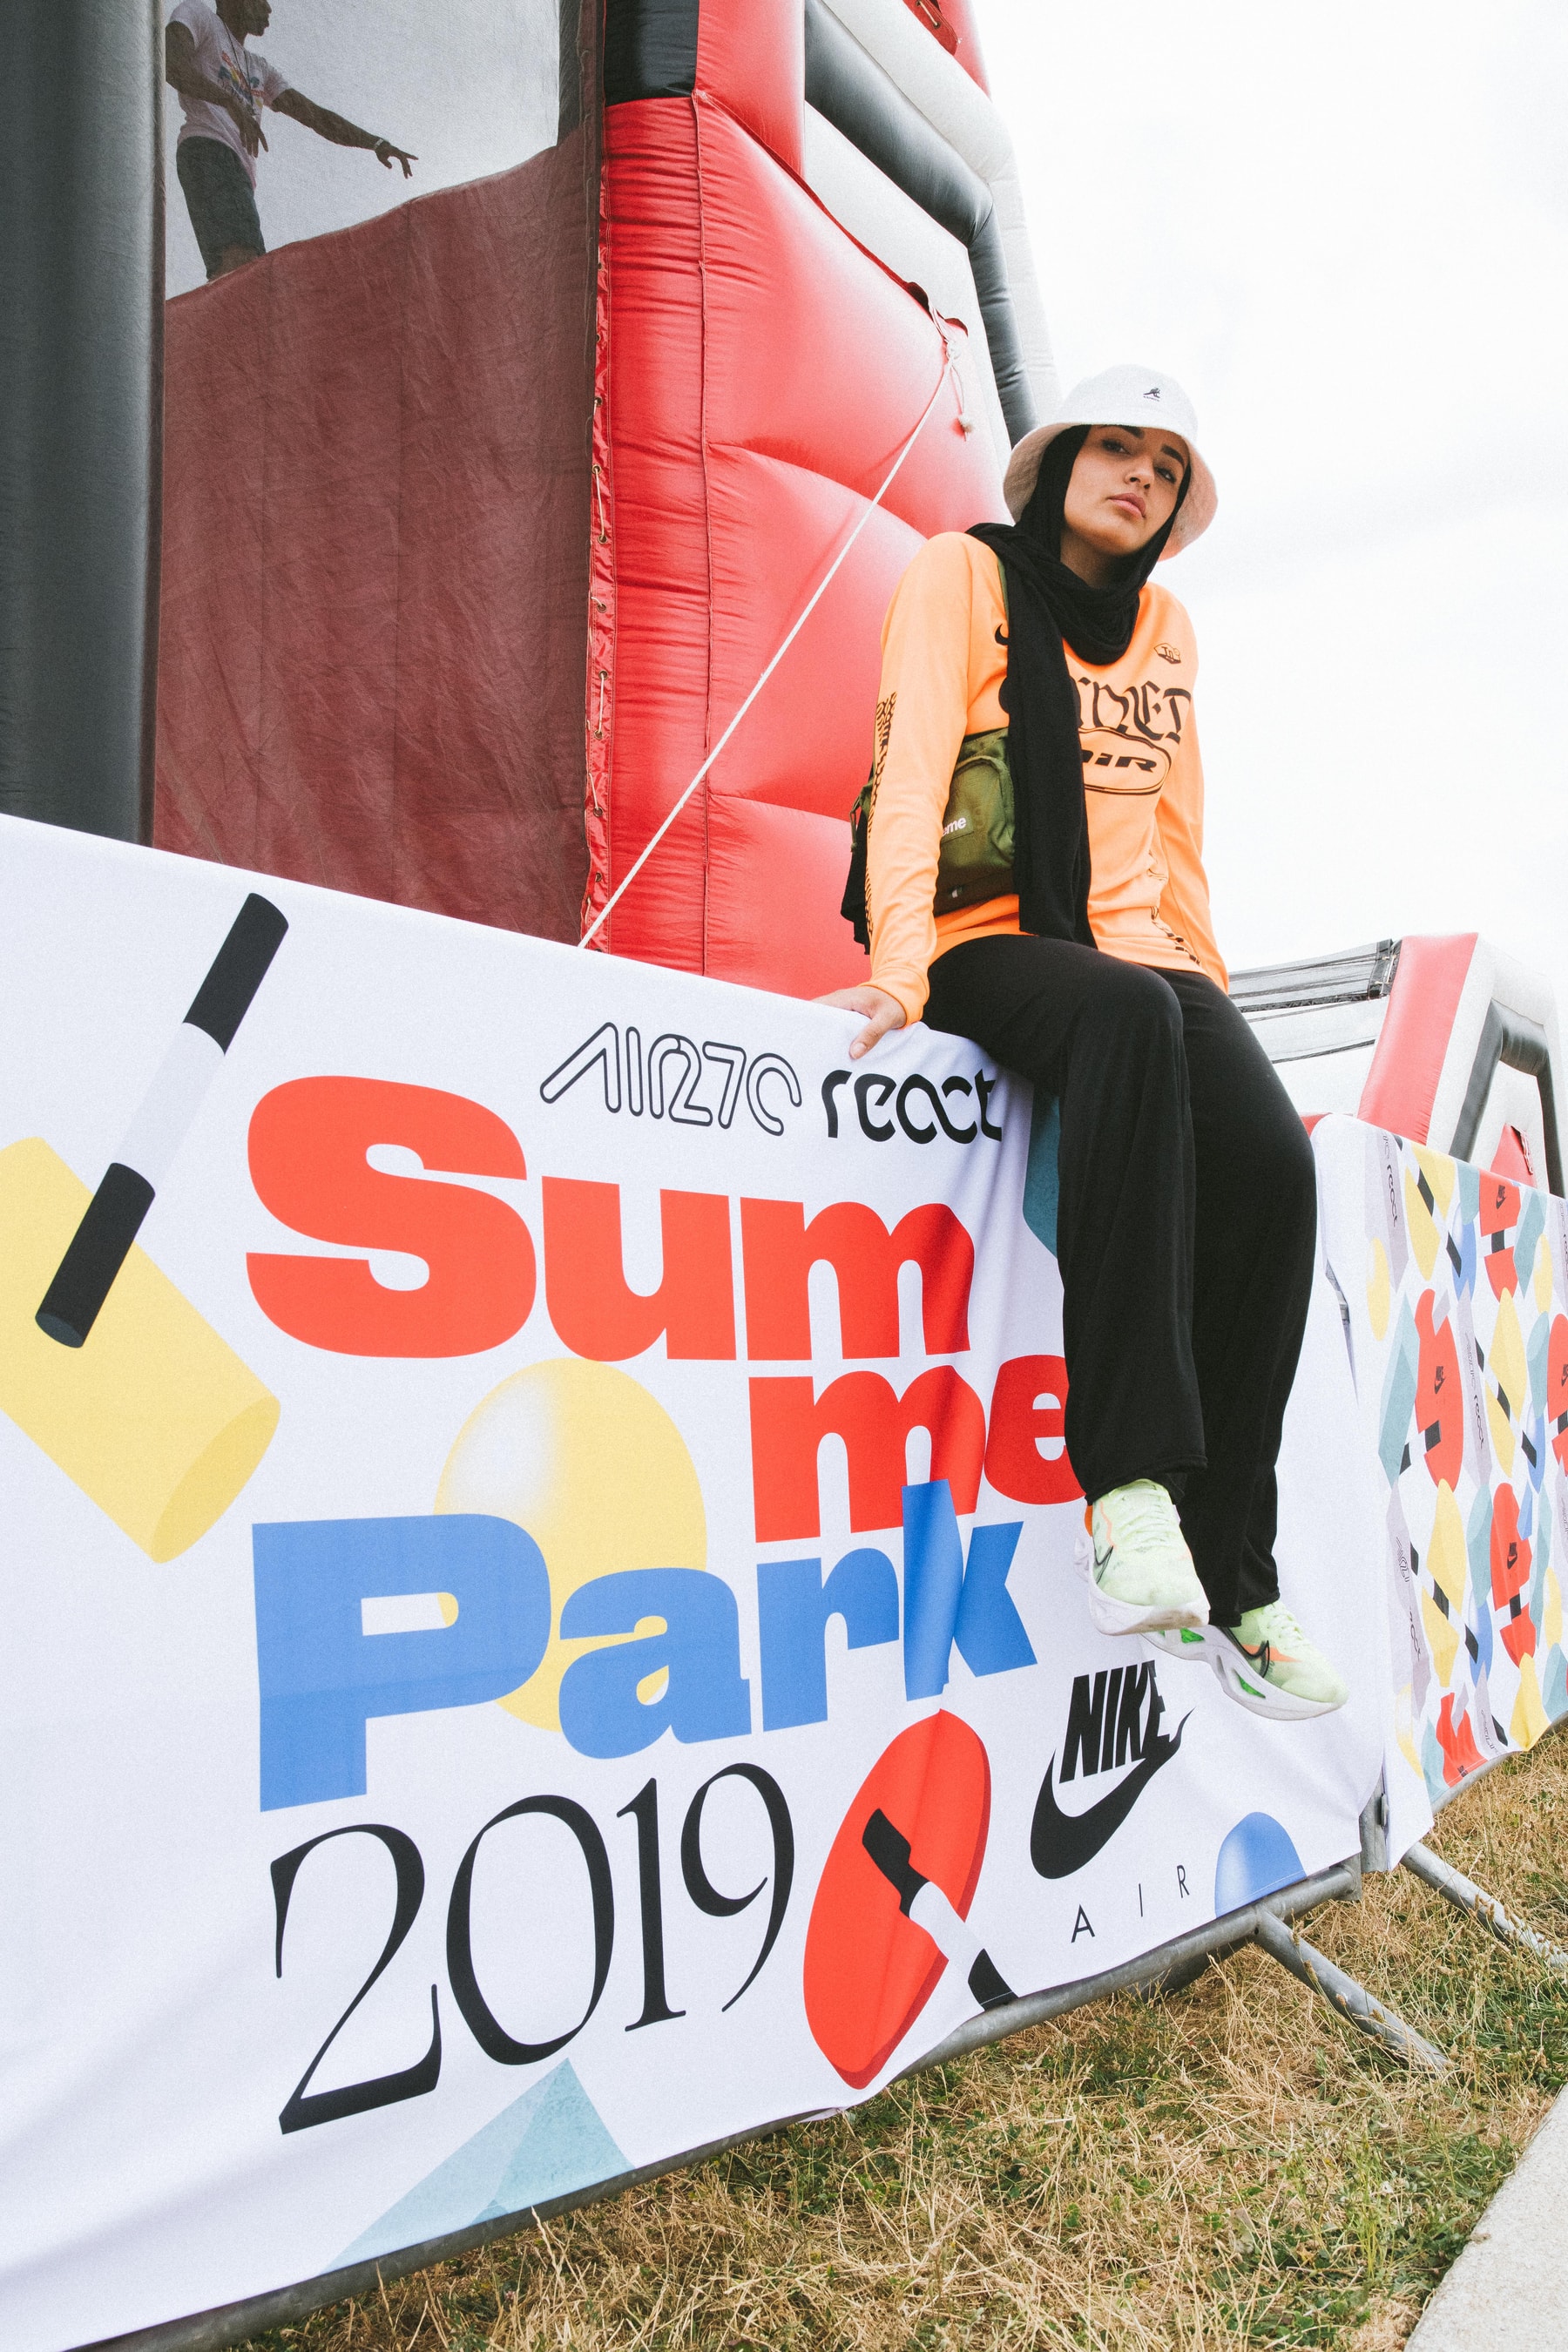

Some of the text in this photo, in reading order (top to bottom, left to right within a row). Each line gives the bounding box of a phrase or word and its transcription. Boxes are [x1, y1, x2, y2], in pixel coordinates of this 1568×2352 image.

[247, 1075, 976, 1362] Sum
[821, 1067, 1003, 1145] react
[747, 1355, 1087, 1544] me
[252, 1478, 1038, 1813] Park
[1059, 1659, 1171, 1784] NIKE
[269, 1761, 795, 2135] 2019
